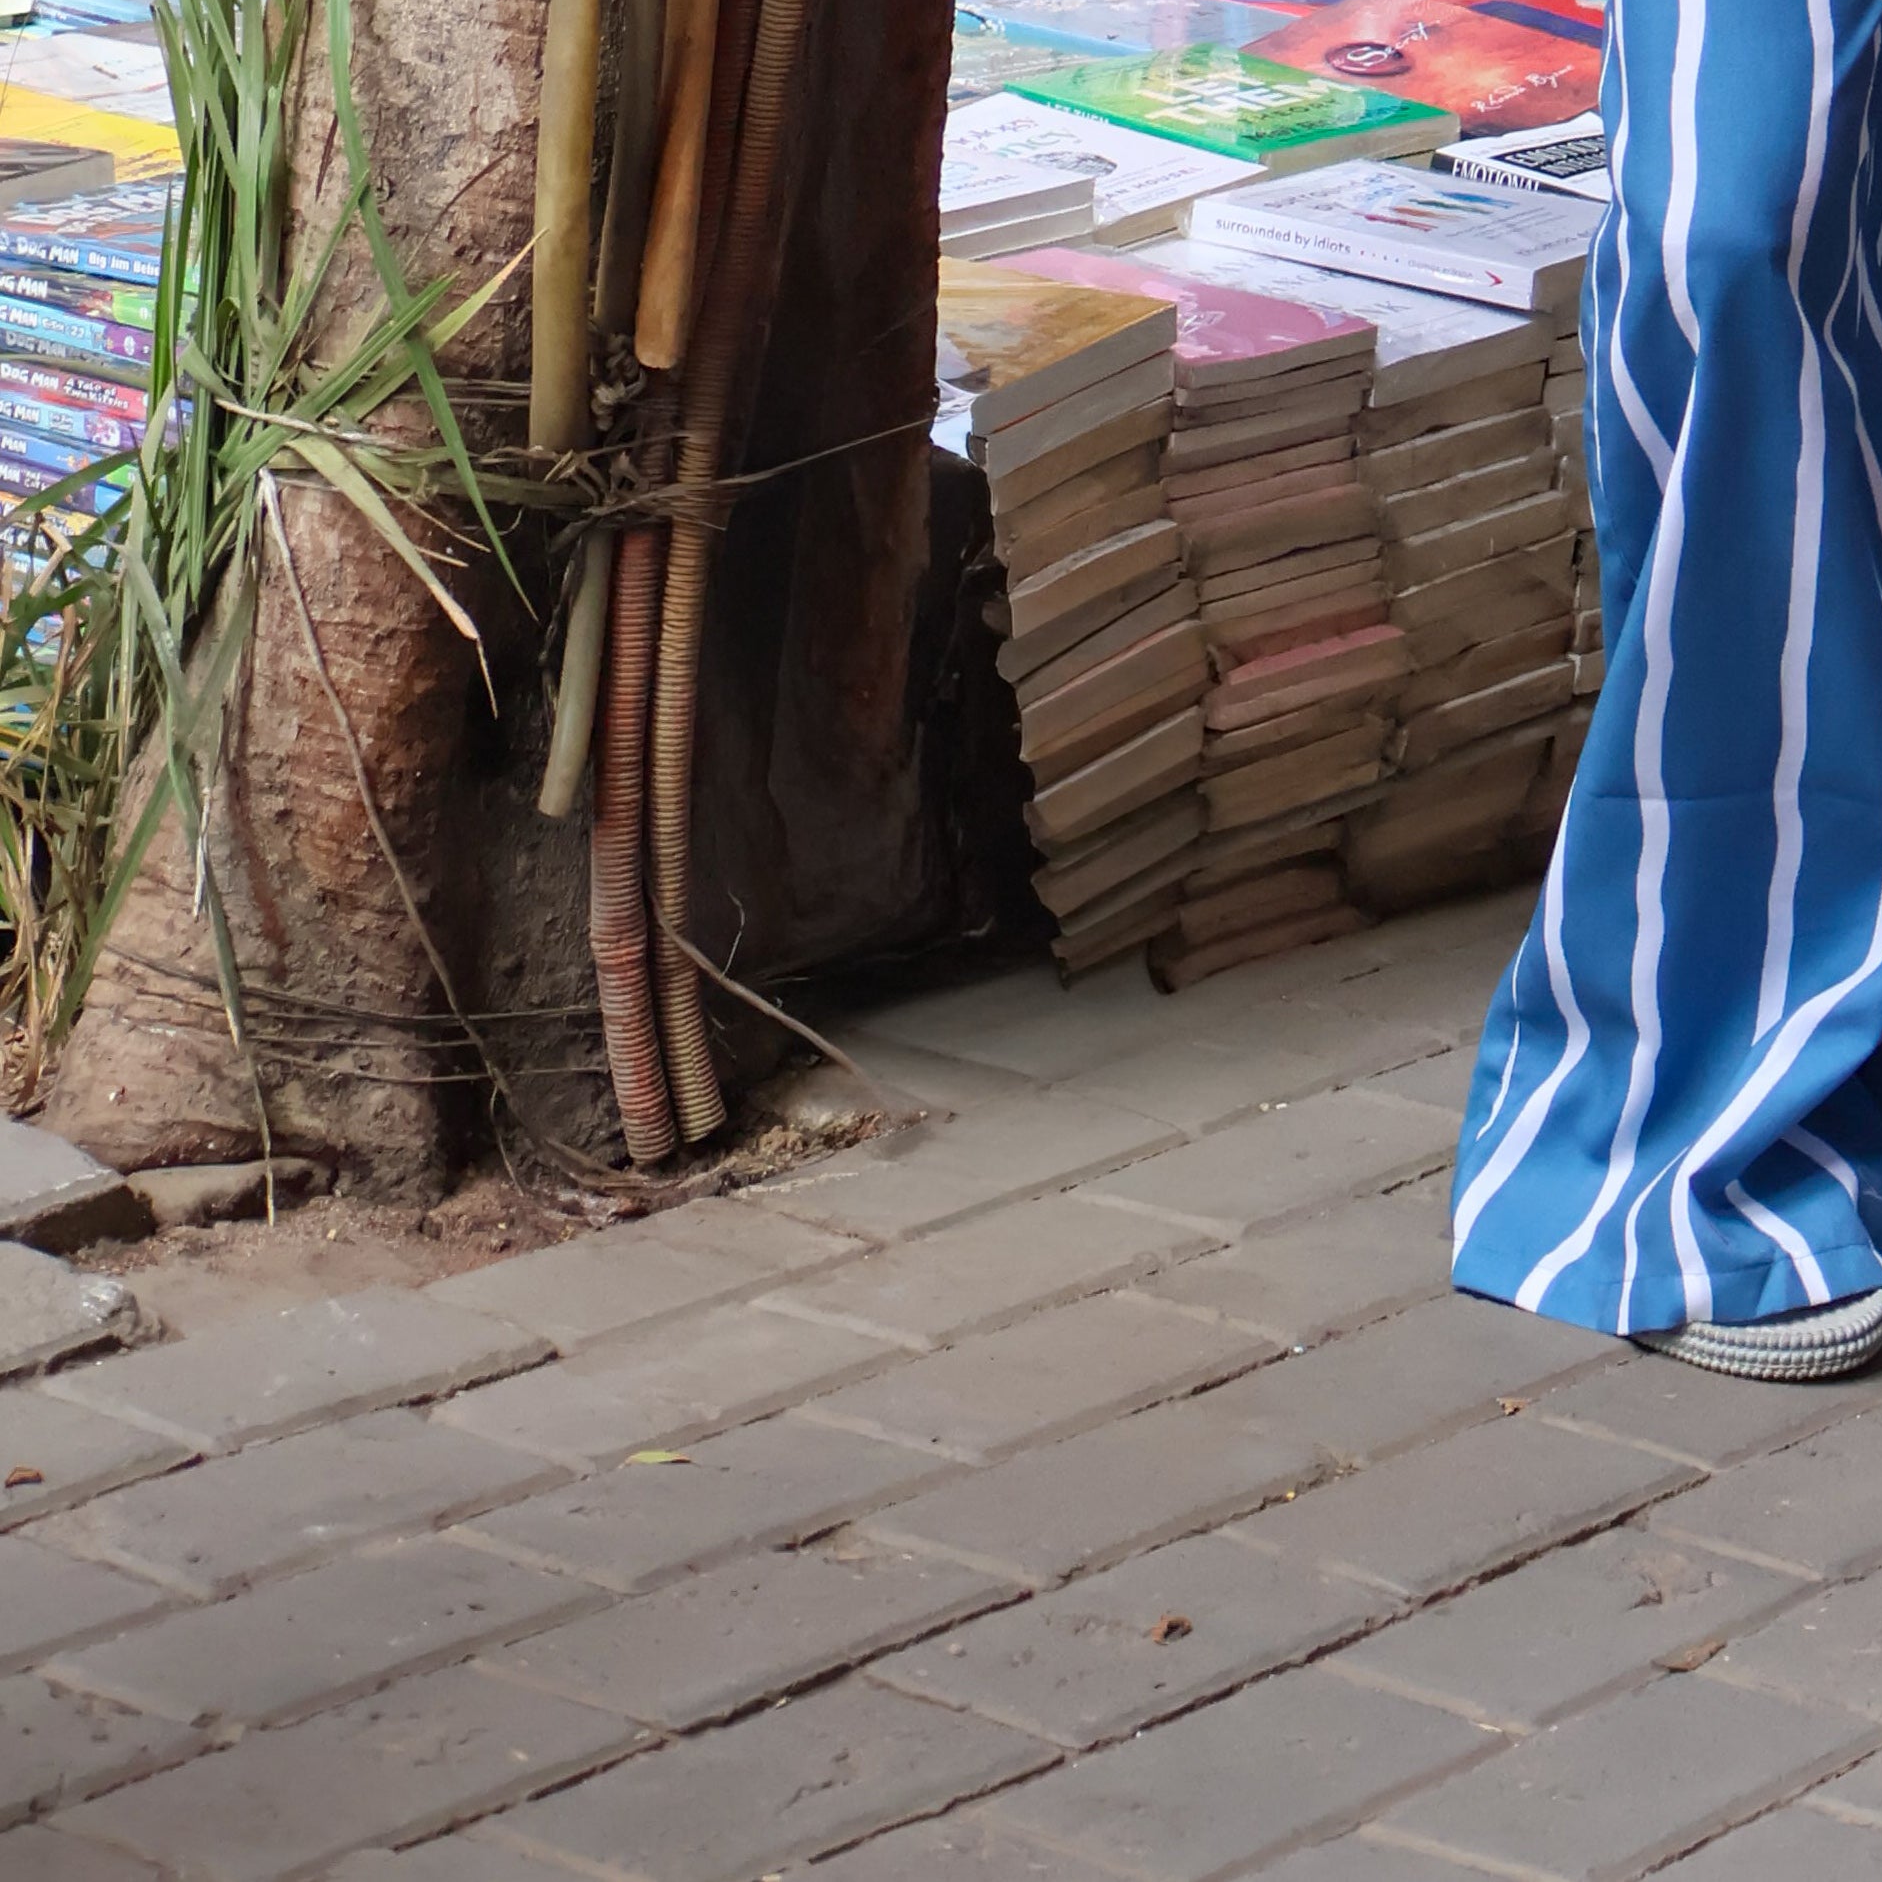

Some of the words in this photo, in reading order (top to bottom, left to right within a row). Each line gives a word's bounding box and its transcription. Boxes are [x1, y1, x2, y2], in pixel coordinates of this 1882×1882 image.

[1215, 216, 1291, 243] surrounded
[1294, 234, 1311, 250] by
[1313, 235, 1351, 255] idiots
[16, 236, 47, 259] DOG
[50, 245, 80, 265] MAN
[88, 252, 108, 270] Big
[111, 255, 130, 272] Jim
[18, 276, 48, 298] MAN
[10, 307, 38, 328] MAN
[38, 340, 67, 358] MAN
[1, 362, 28, 383] DOG
[31, 371, 59, 390] MAN
[14, 403, 40, 423] MAN
